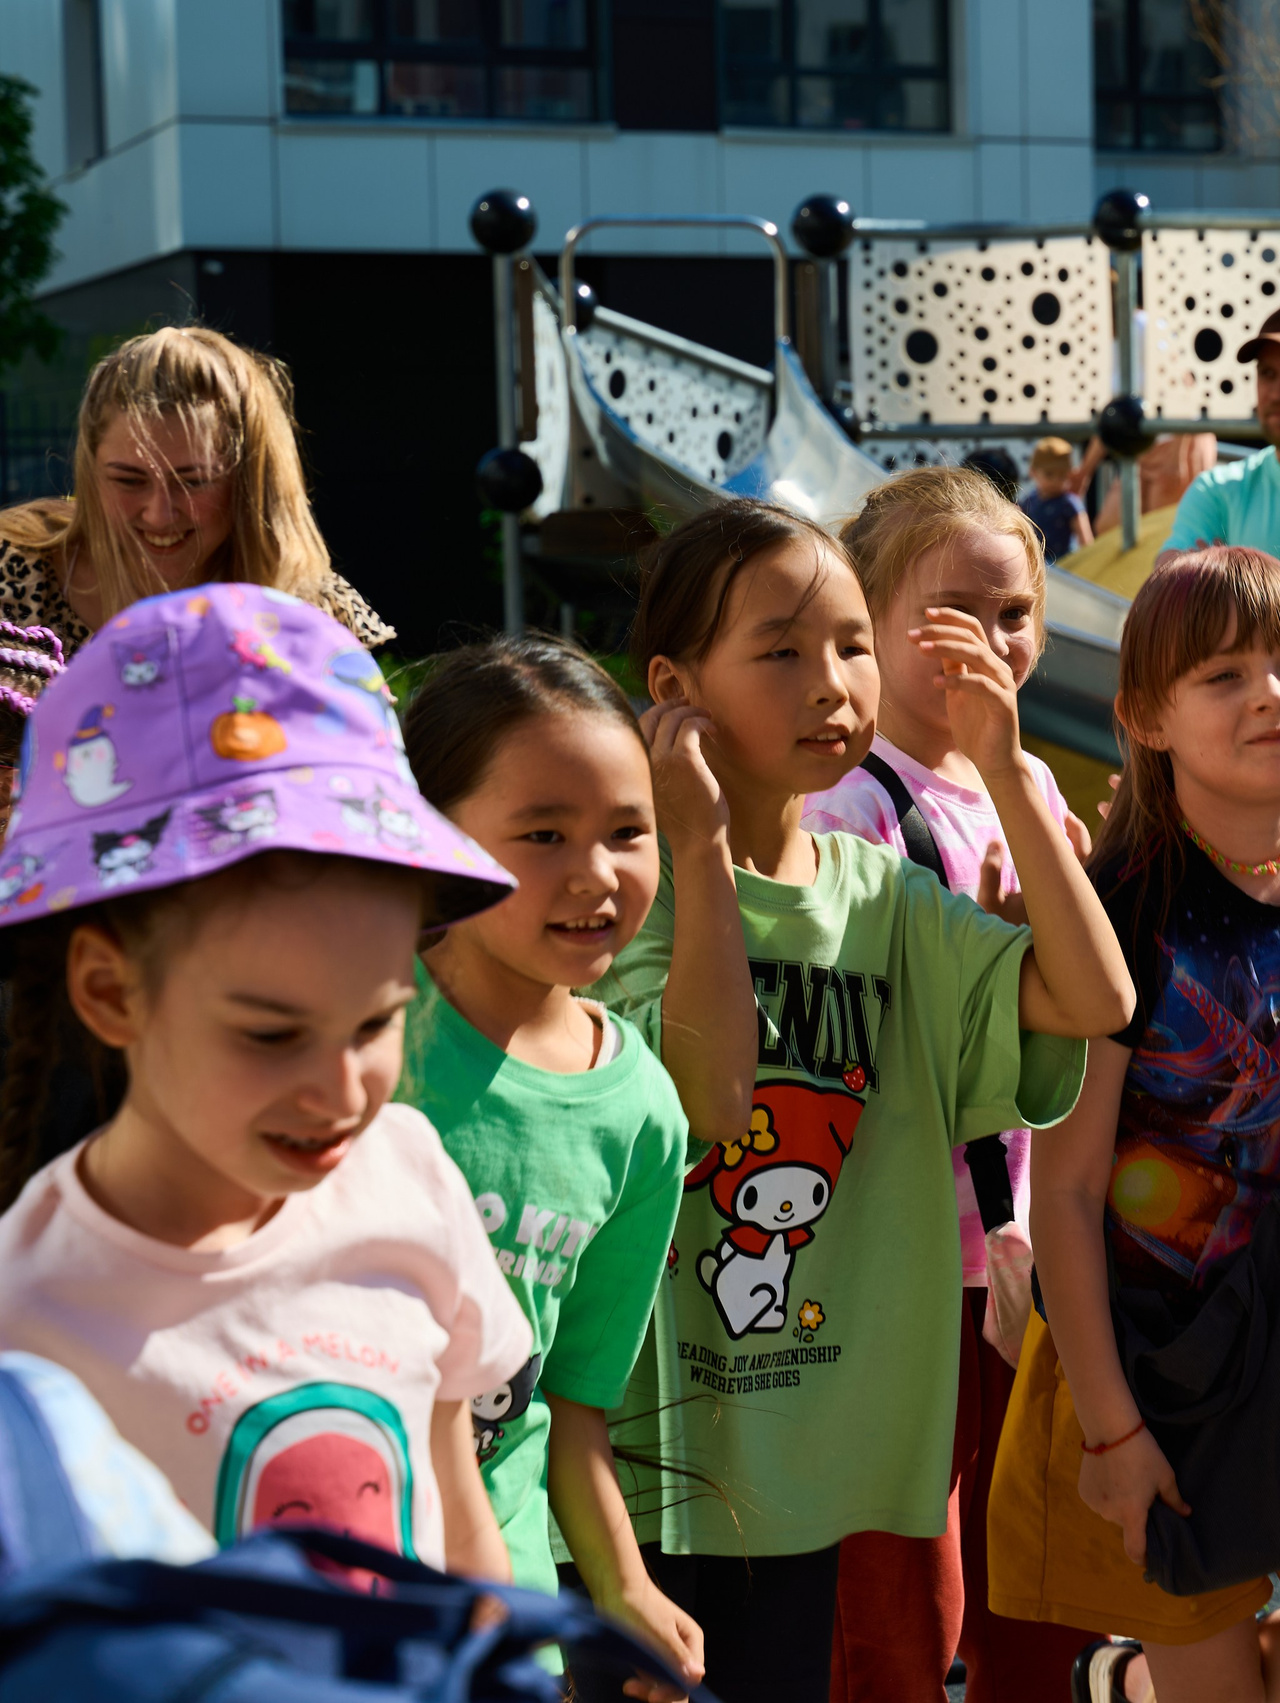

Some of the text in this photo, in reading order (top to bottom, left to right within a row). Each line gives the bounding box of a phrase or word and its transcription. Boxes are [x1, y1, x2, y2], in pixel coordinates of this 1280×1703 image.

[515, 1204, 599, 1258] KIT
[690, 1365, 801, 1395] WHEREVER SHE GOES
[729, 1354, 750, 1374] JOY
[749, 1354, 771, 1372] AND
[770, 1345, 842, 1368] FRIENDSHIP
[186, 1371, 238, 1436] ONE
[276, 1337, 297, 1363] A
[302, 1332, 400, 1376] MELON
